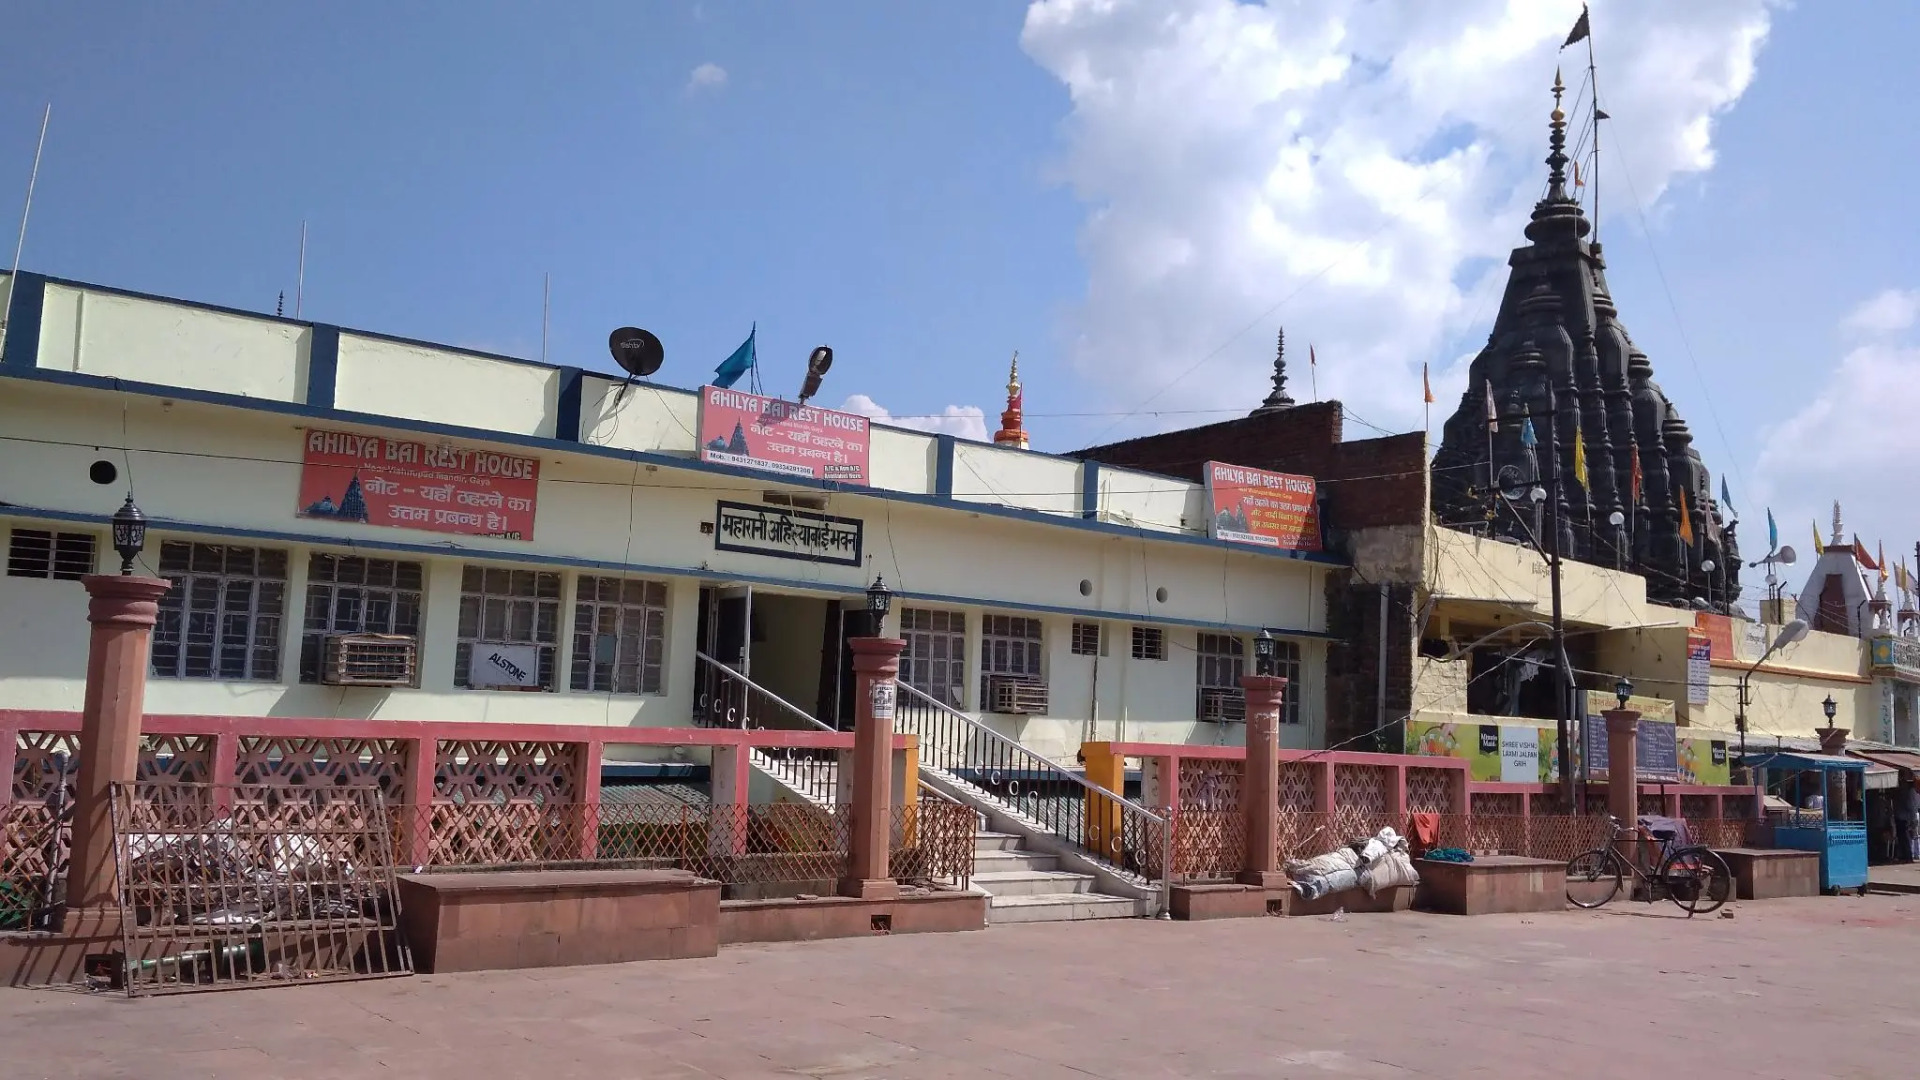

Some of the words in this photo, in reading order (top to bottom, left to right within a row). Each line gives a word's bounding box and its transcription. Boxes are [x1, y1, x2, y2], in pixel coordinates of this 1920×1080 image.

[710, 391, 758, 412] AHILYA
[762, 400, 784, 417] BAI
[789, 404, 820, 424] REST
[824, 413, 863, 432] HOUSE
[750, 423, 773, 437] नोट
[812, 436, 844, 450] ठहरने
[846, 441, 863, 453] का
[766, 442, 795, 455] उत्तम
[798, 446, 830, 462] प्रबन्ध
[308, 431, 379, 459] AHILYA
[385, 440, 418, 464] BAI
[425, 444, 471, 470] REST
[474, 452, 533, 479] HOUSE
[365, 476, 400, 497] नोट
[456, 489, 504, 509] ठहरने
[508, 496, 532, 512] का
[470, 476, 490, 487] Gaya
[1214, 466, 1244, 482] AHILYA
[1246, 472, 1261, 486] BAI
[1262, 474, 1283, 490] REST
[1285, 478, 1313, 494] HOUSE
[388, 504, 431, 523] उत्तम
[435, 510, 484, 528] प्रबन्ध
[487, 512, 508, 531] है।
[722, 512, 767, 541] महारानी
[768, 514, 829, 551] अहिल्याबाई
[488, 652, 526, 682] ALSTONE
[1502, 741, 1518, 749] SHREE
[1503, 750, 1518, 758] LAXMI
